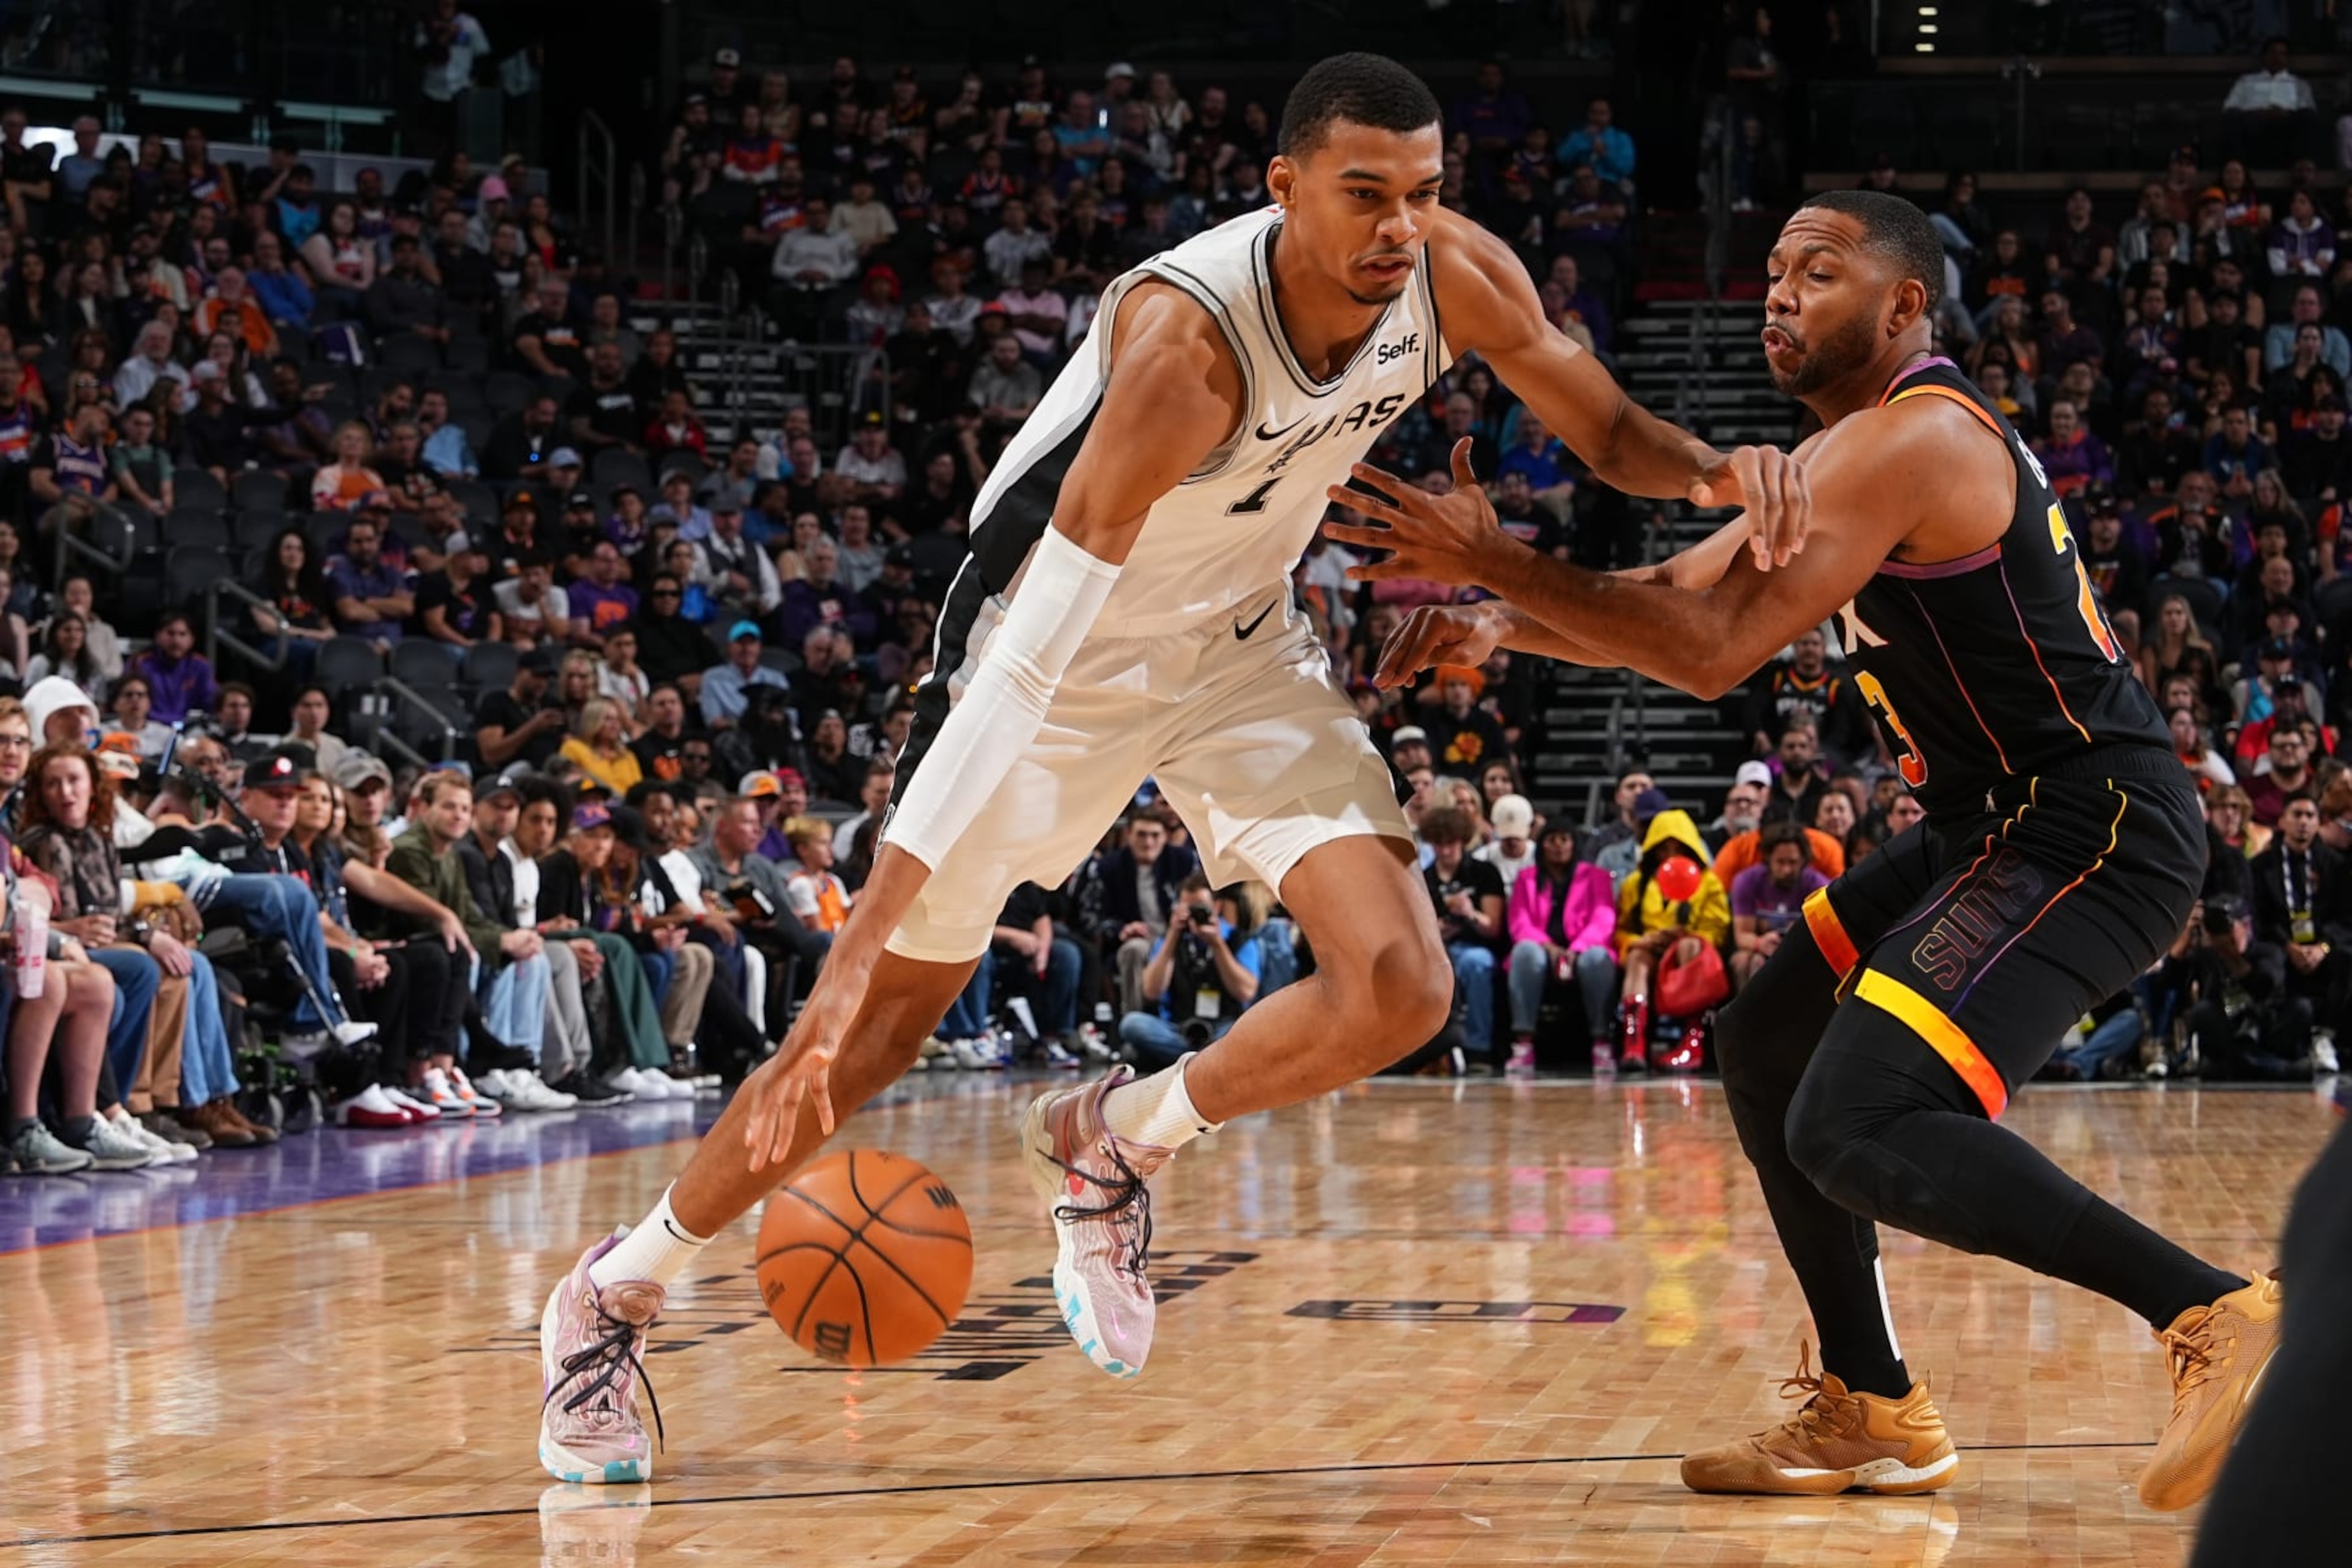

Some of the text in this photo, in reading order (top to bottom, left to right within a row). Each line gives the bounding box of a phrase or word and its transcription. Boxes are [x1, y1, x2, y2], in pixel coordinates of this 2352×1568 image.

[1378, 333, 1420, 365] Self.
[1224, 476, 1284, 516] 1
[1912, 846, 2045, 991] SUNS
